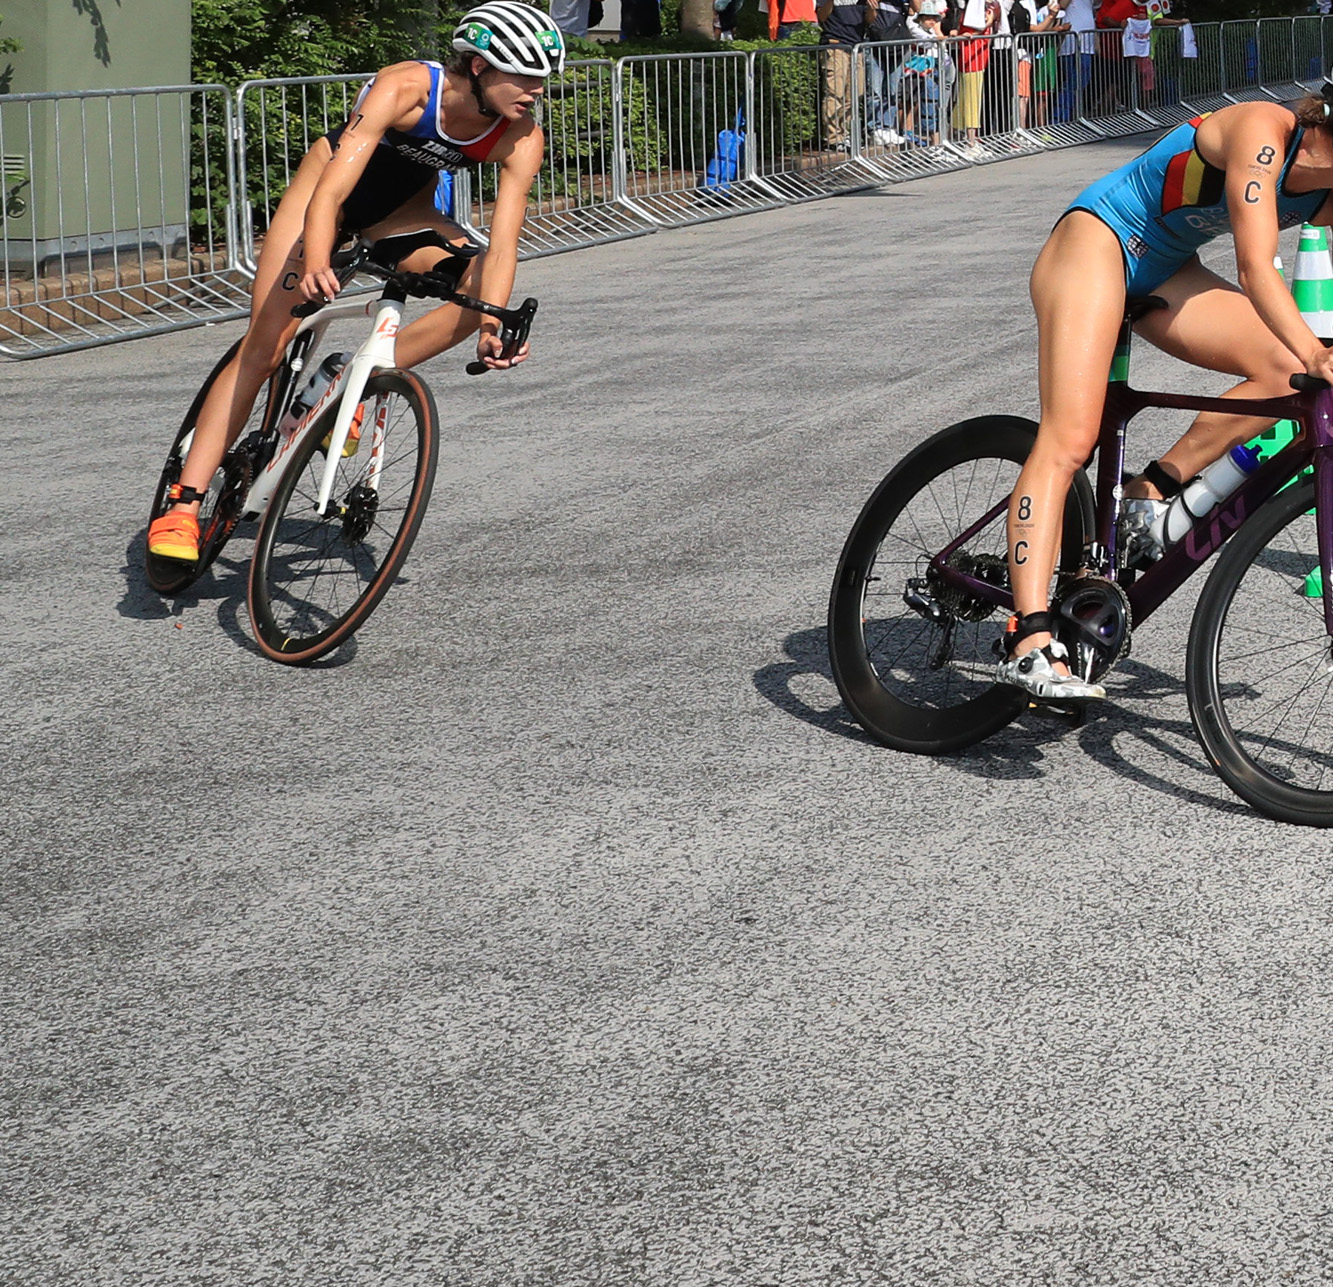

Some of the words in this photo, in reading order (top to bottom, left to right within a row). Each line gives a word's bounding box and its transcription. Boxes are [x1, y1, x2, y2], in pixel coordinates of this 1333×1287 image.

[466, 27, 478, 41] 1C
[541, 35, 554, 47] 1C
[1256, 145, 1276, 166] 8
[1244, 180, 1262, 204] C
[282, 272, 299, 292] C
[1017, 495, 1032, 521] 8
[1014, 540, 1029, 565] C
